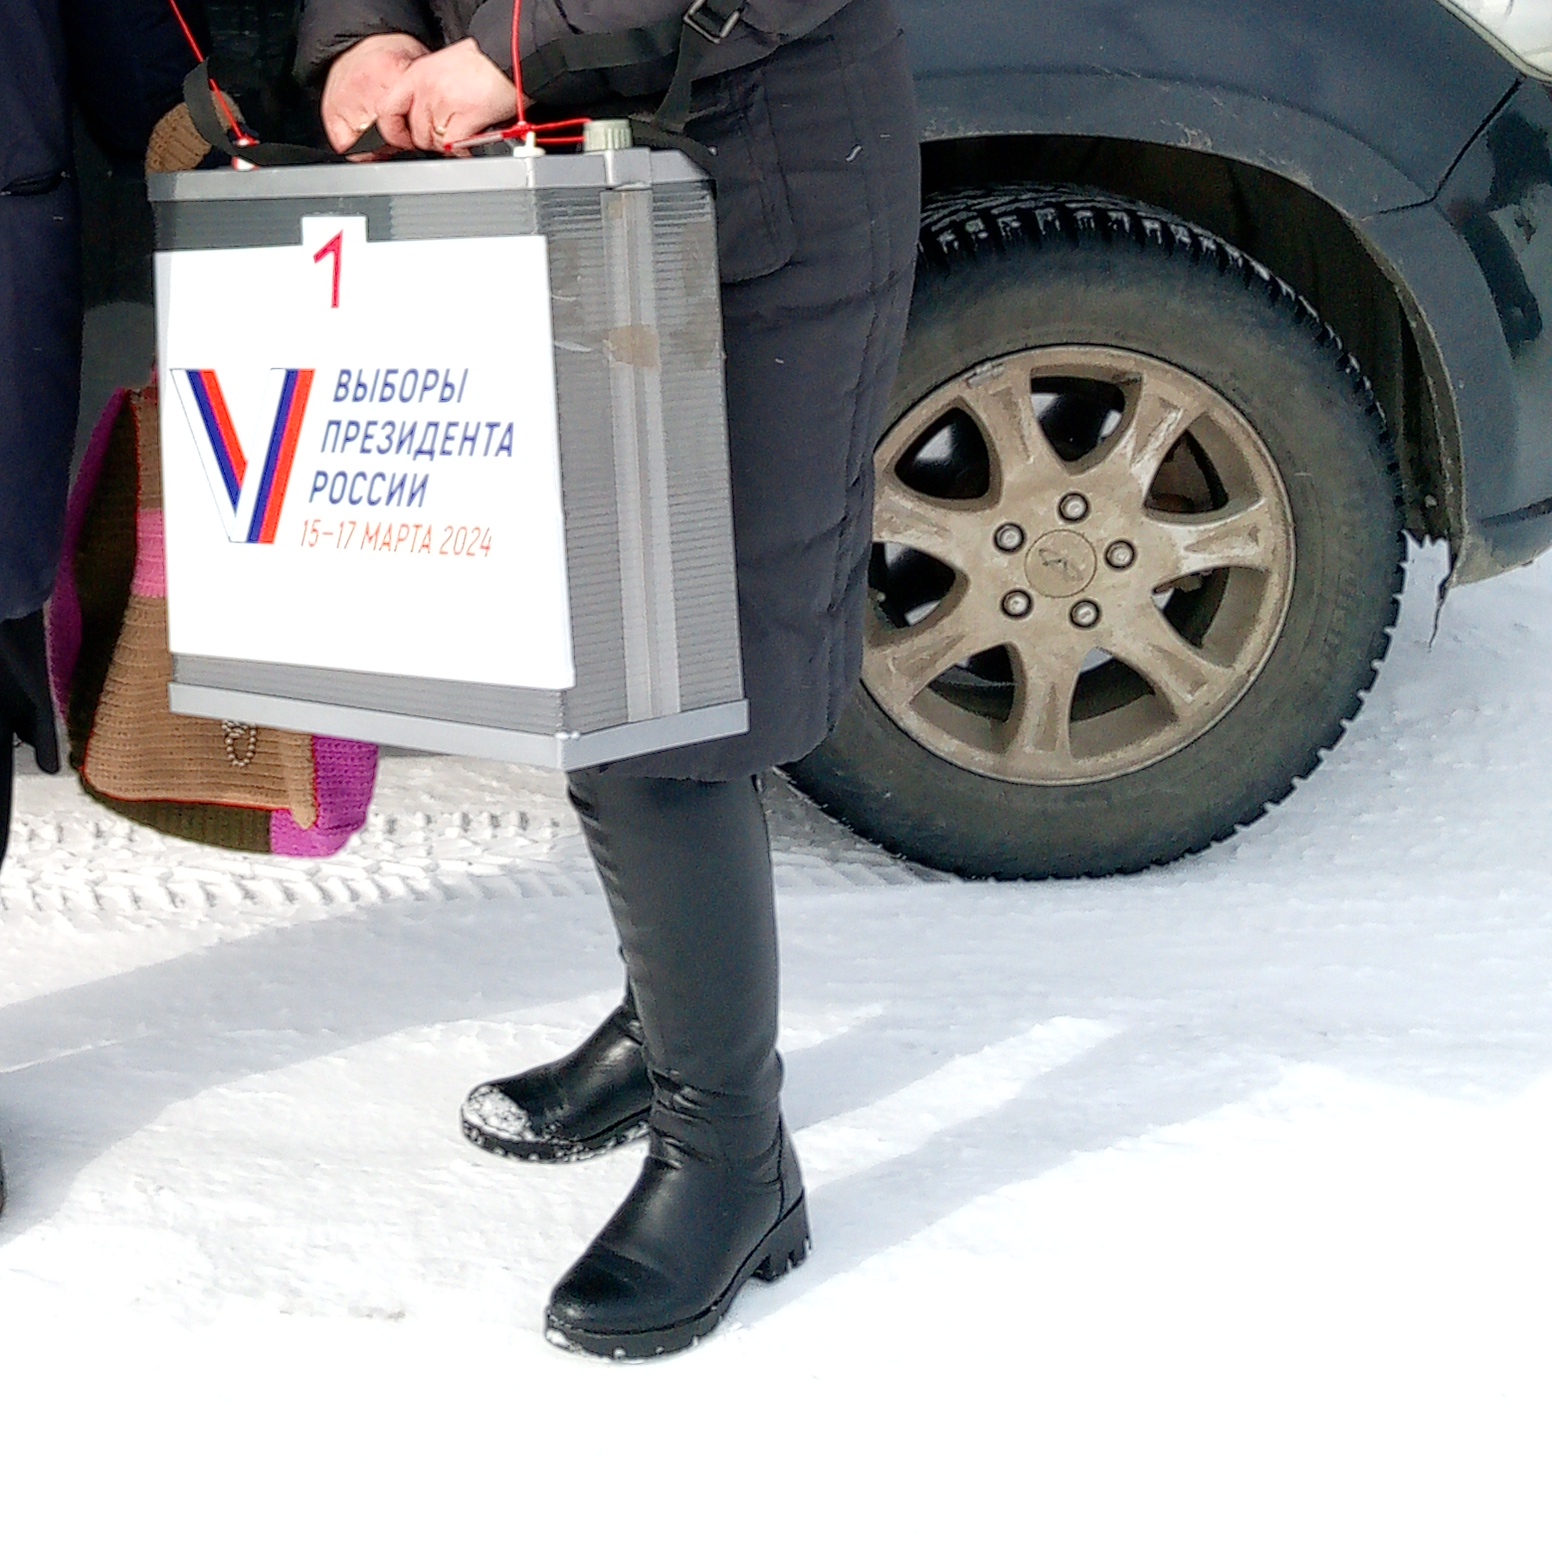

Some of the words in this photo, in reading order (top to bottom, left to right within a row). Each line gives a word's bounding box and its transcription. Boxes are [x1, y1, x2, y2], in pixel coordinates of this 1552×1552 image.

[313, 229, 344, 309] 1
[332, 367, 469, 404] ВЫБОРЫ
[320, 419, 515, 462] ПРЕЗИДЕНТА
[308, 469, 430, 508] РОССИИ
[300, 518, 357, 550] 15-17
[359, 521, 433, 554] МАРТА
[438, 525, 493, 558] 2024
